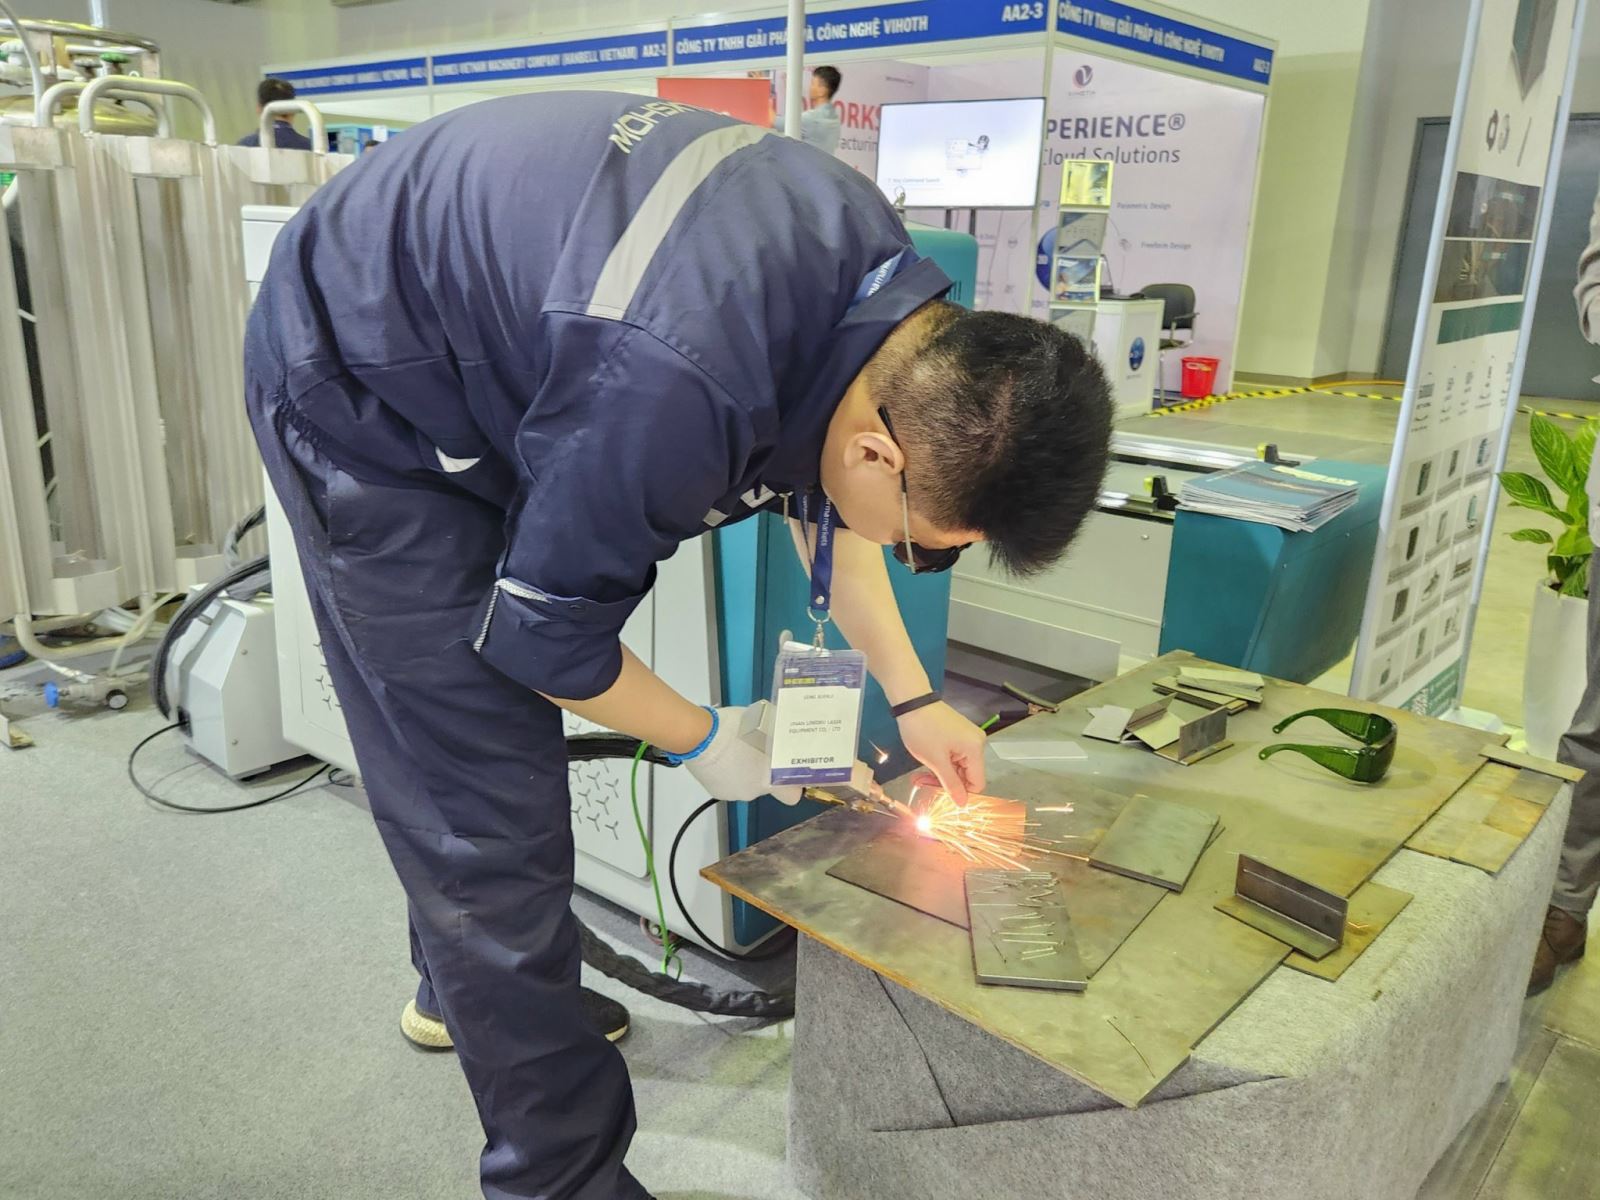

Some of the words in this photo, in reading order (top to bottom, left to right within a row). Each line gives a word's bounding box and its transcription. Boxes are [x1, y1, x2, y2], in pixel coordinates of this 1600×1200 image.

[676, 38, 702, 54] CÔNG
[703, 38, 716, 52] TY
[717, 35, 745, 51] TNHH
[746, 28, 767, 48] GIẢI
[816, 22, 848, 41] CÔNG
[849, 17, 880, 38] NGHỆ
[883, 15, 929, 34] VIHOTH
[1002, 2, 1044, 22] AA2-3
[1046, 113, 1186, 140] PERIENCE®
[1092, 145, 1181, 165] Solutions
[791, 756, 835, 765] EXHIBITOR
